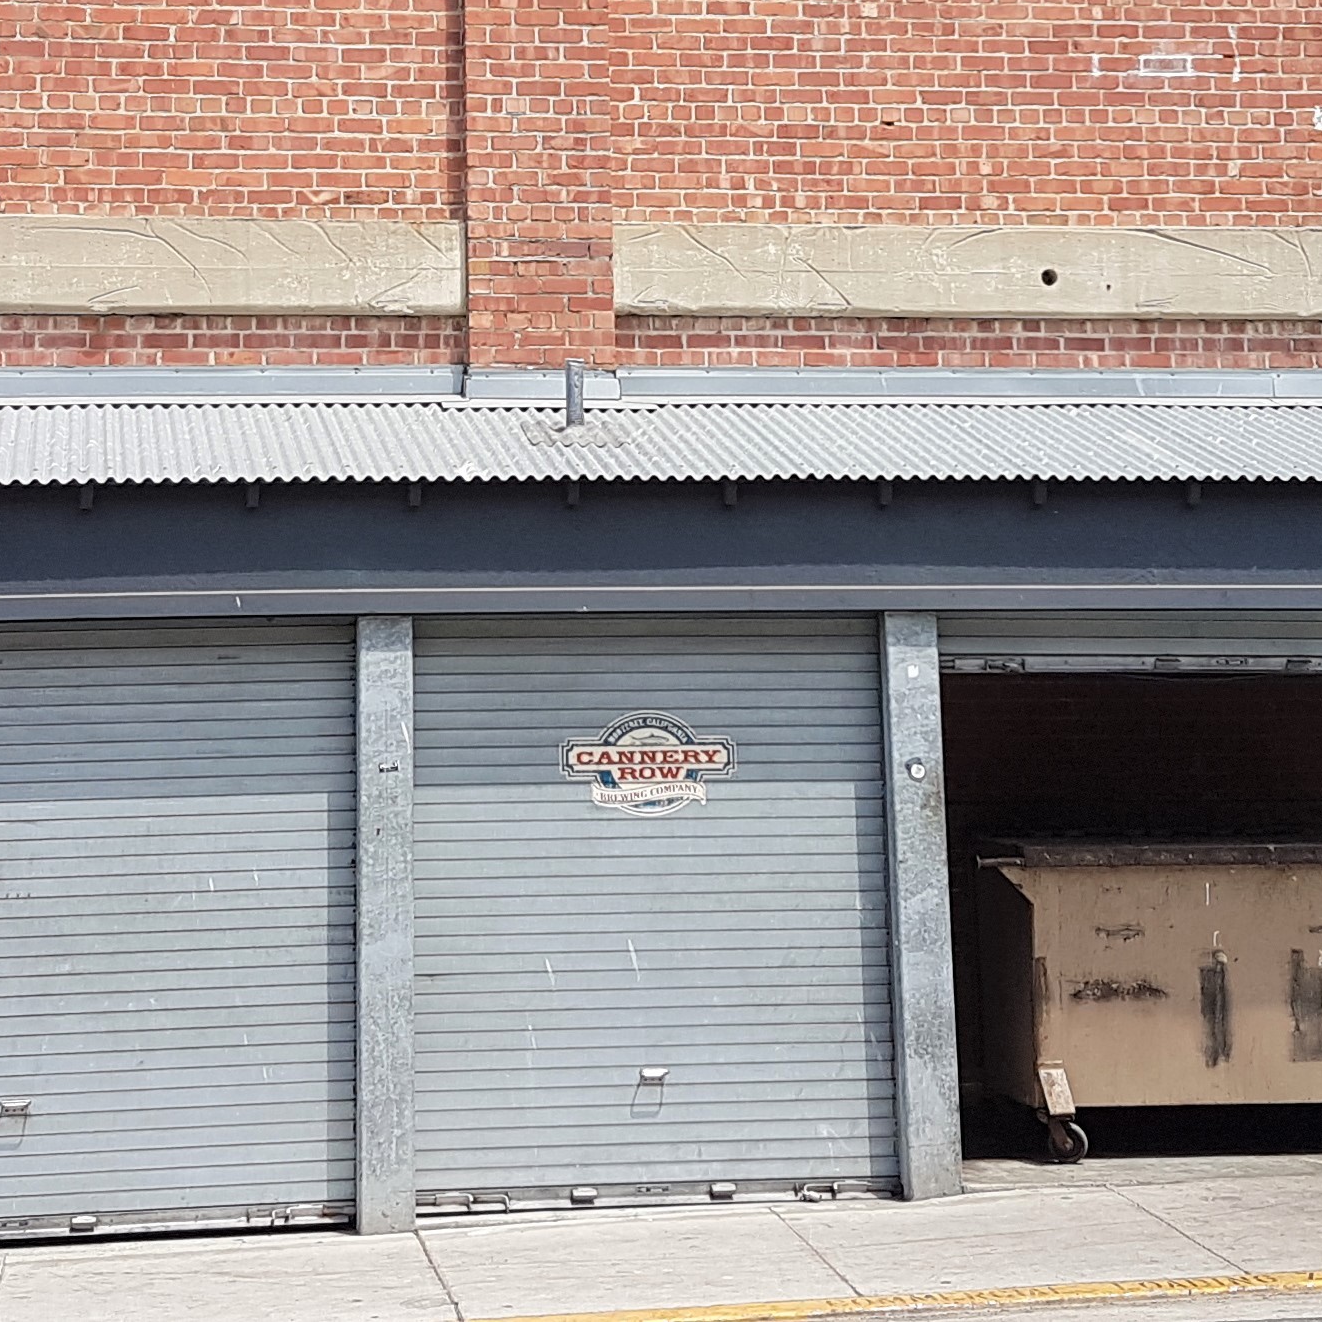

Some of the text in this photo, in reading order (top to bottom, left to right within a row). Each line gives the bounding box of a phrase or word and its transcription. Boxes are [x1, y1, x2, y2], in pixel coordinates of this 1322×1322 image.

[576, 749, 722, 765] CANNERY
[617, 766, 685, 781] ROW
[600, 783, 698, 802] BREWING COMPANY
